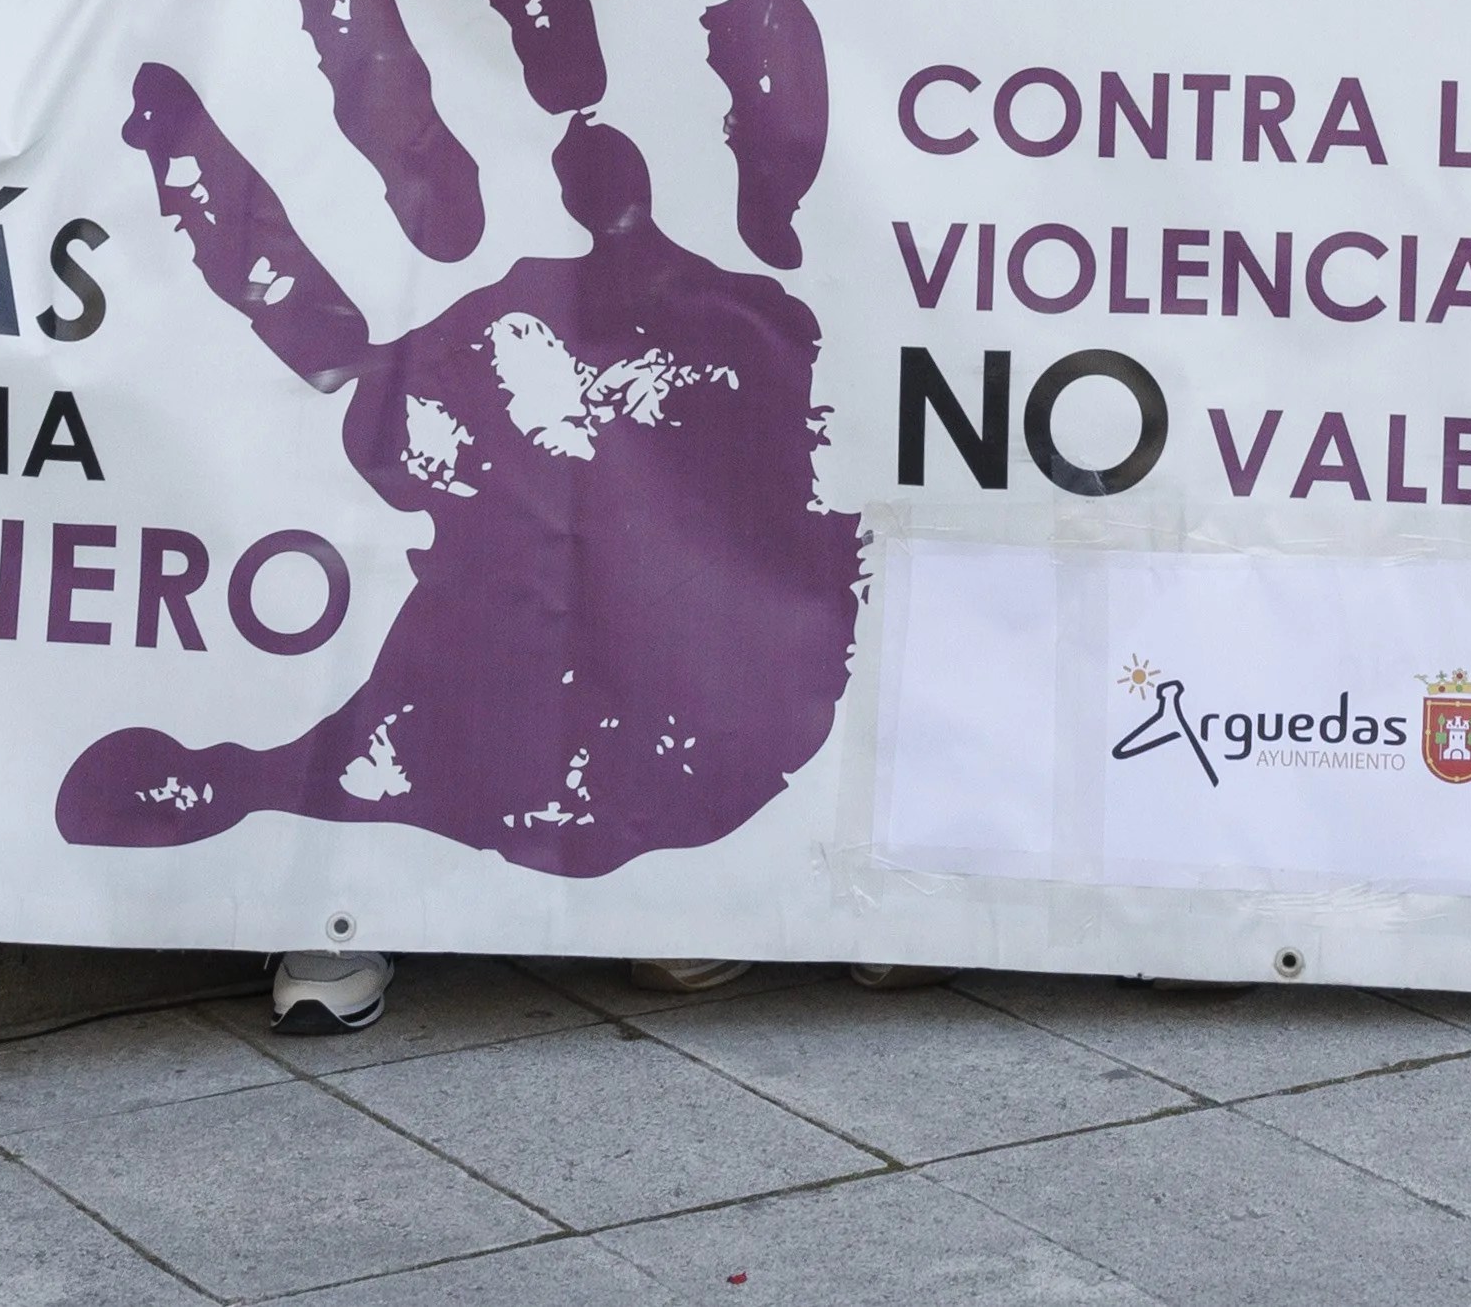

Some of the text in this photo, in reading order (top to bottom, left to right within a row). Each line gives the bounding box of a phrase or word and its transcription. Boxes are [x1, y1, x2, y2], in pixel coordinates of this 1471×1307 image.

[897, 65, 1389, 166] CONTRA
[897, 346, 1170, 497] NO
[1112, 679, 1407, 787] Arguedas
[1256, 749, 1406, 772] AYUNTAMIENTO
